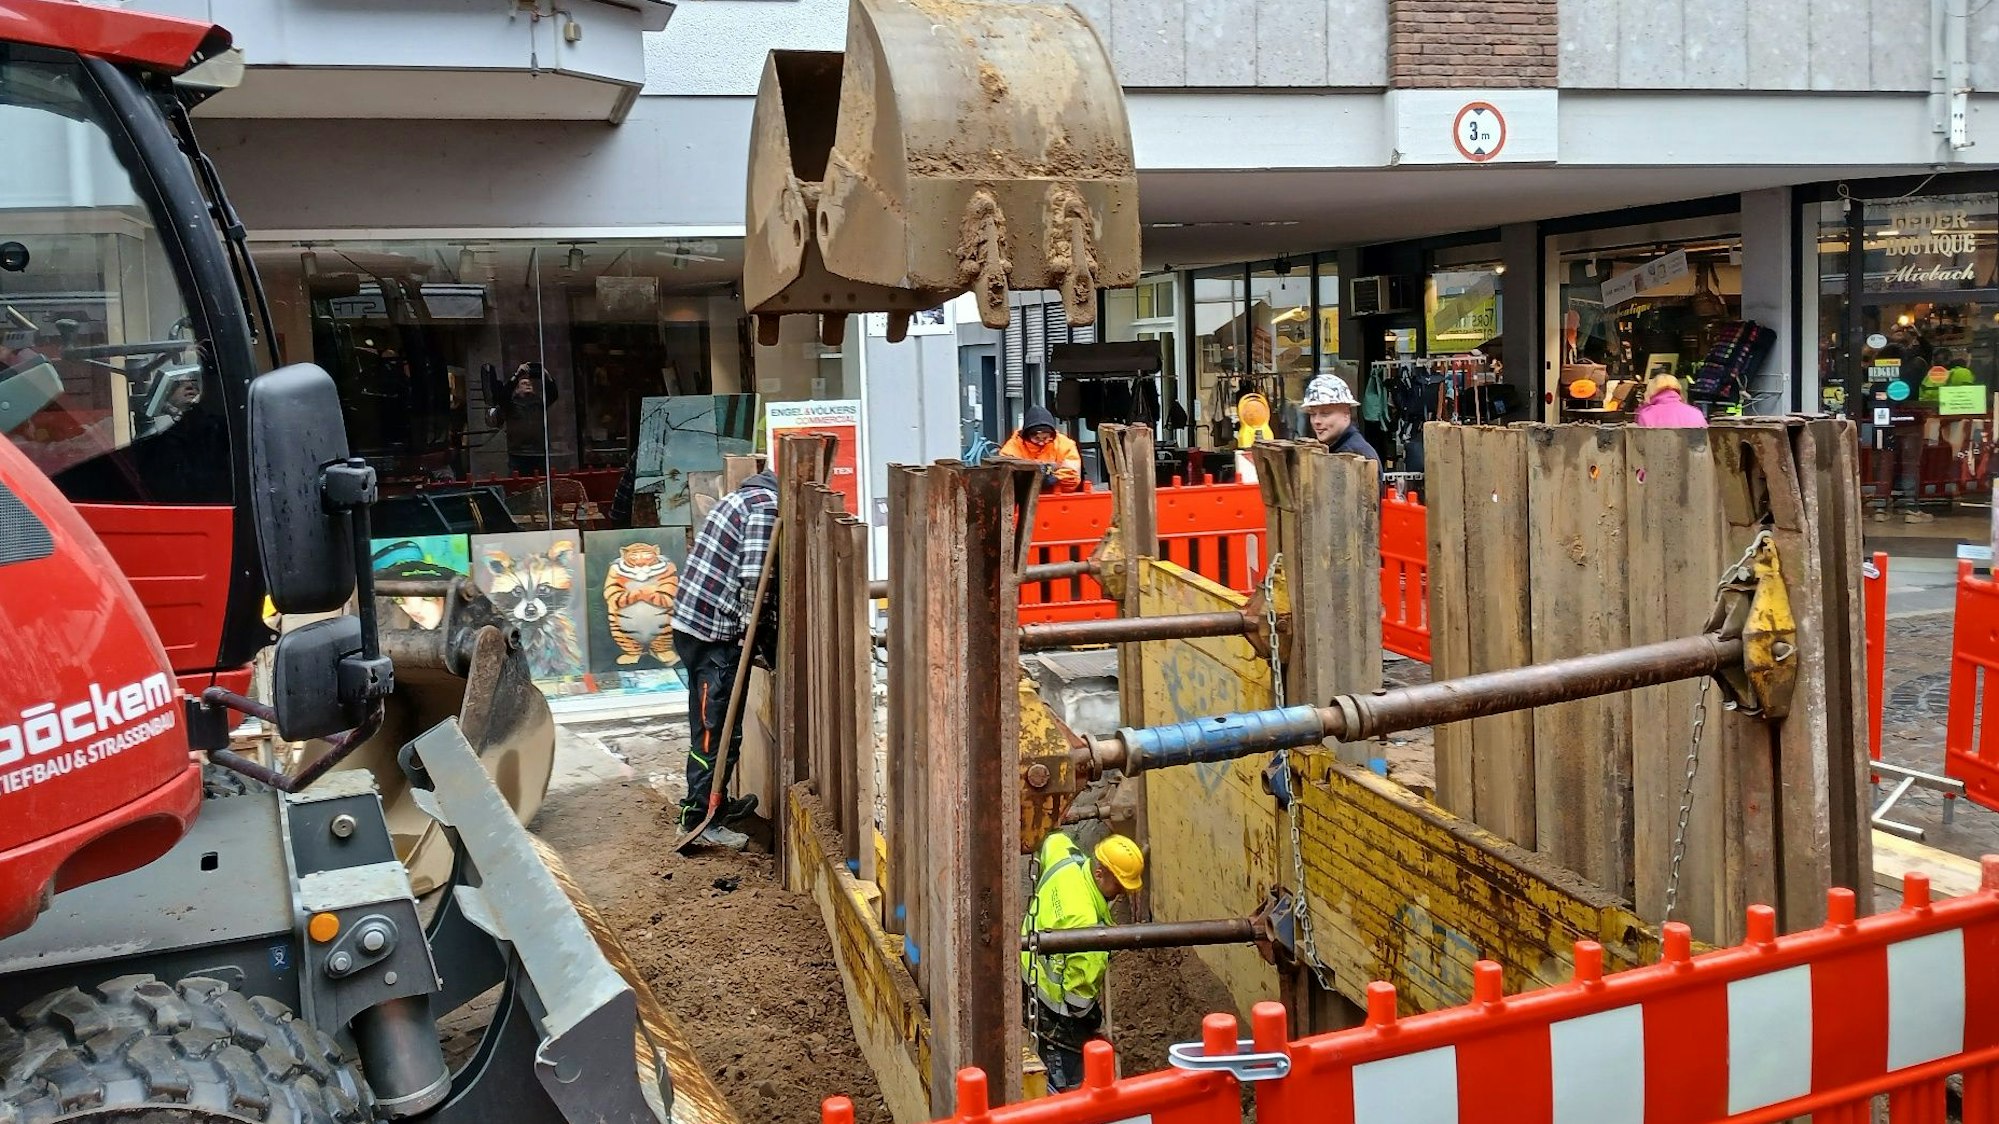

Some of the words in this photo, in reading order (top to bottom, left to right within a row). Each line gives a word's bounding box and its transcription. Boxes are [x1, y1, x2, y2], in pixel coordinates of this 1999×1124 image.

[1469, 121, 1479, 141] 3
[1481, 132, 1490, 140] m
[1889, 210, 1969, 231] LEDER
[1885, 233, 1976, 257] BOUTIQUE
[1884, 262, 1976, 283] Miebach
[795, 416, 857, 425] COMMERCIAL
[73, 749, 89, 769] &
[87, 710, 176, 764] STRASSENBAU
